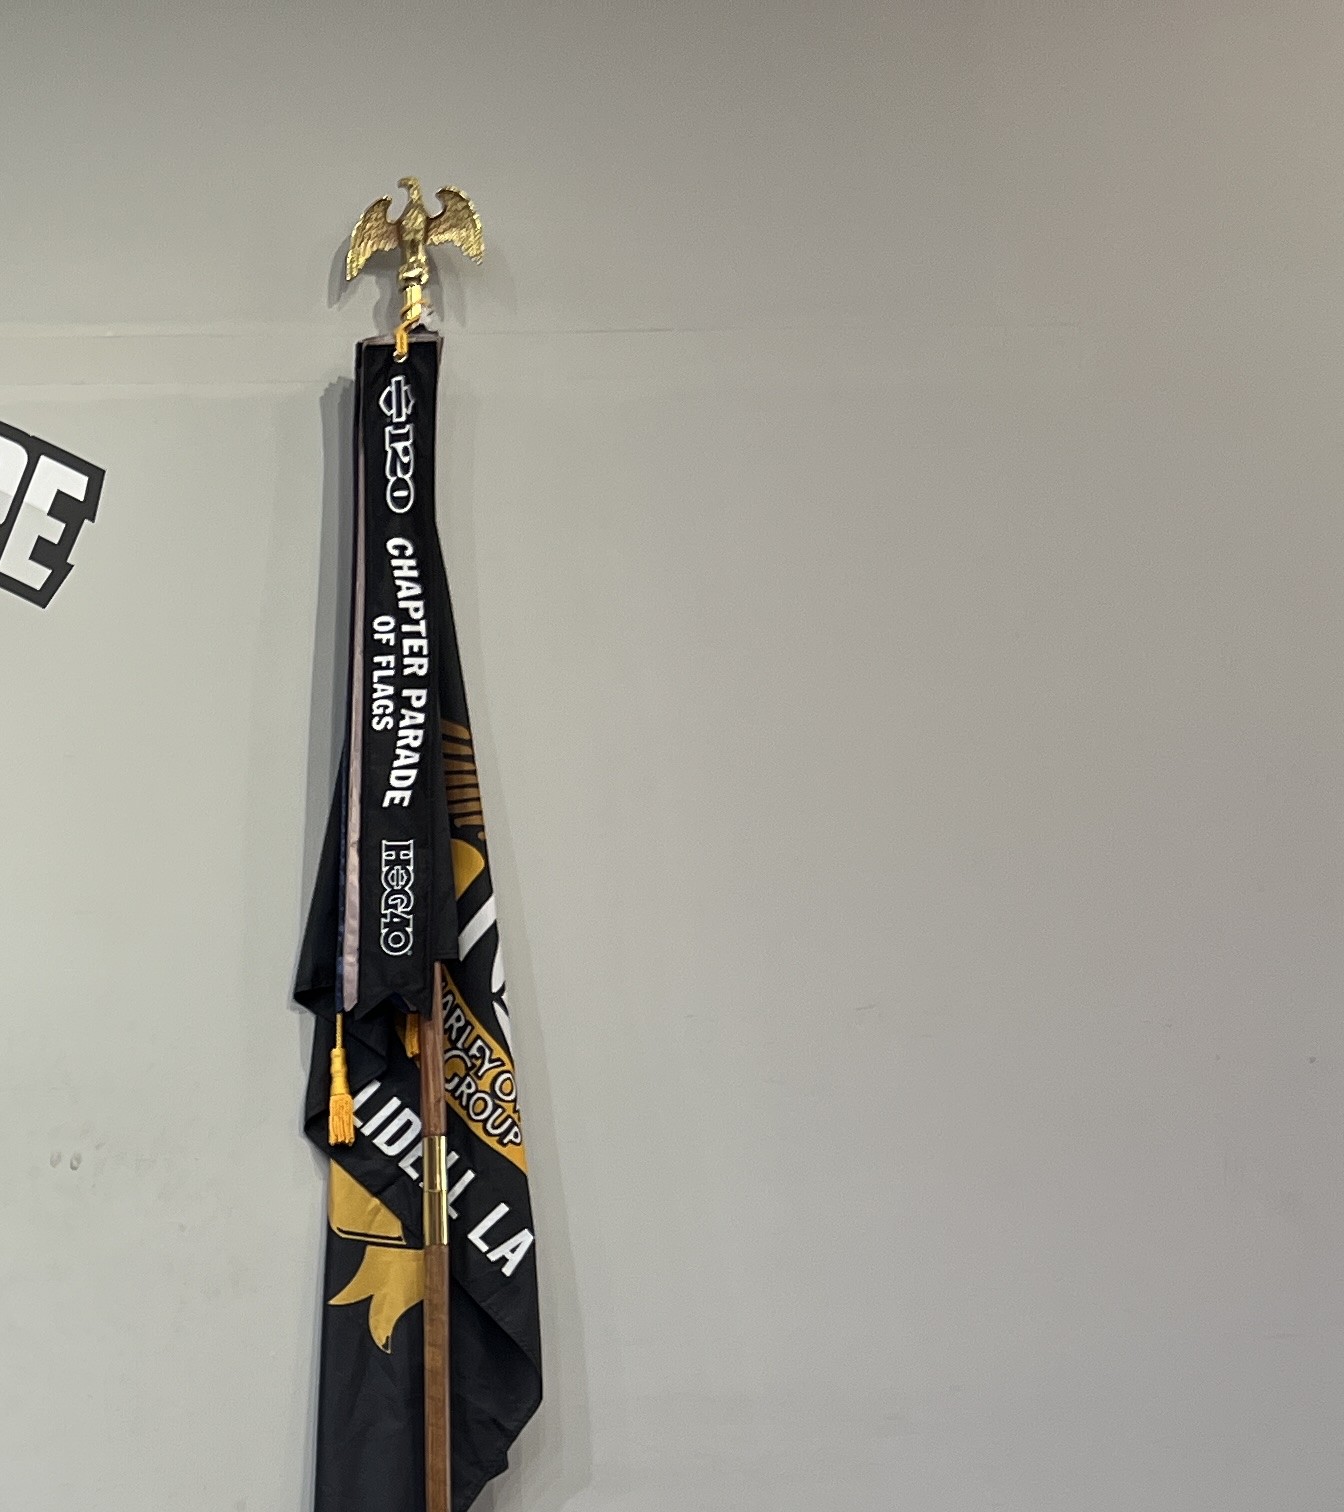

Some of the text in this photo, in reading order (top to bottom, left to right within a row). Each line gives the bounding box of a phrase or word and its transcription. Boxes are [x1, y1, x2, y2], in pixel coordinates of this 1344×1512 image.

[372, 615, 396, 731] OF FLAGS
[382, 537, 429, 808] CHAPTER PARADE
[441, 982, 502, 1077] ARLEY
[443, 1050, 523, 1146] GROUP
[467, 1202, 534, 1278] LA
